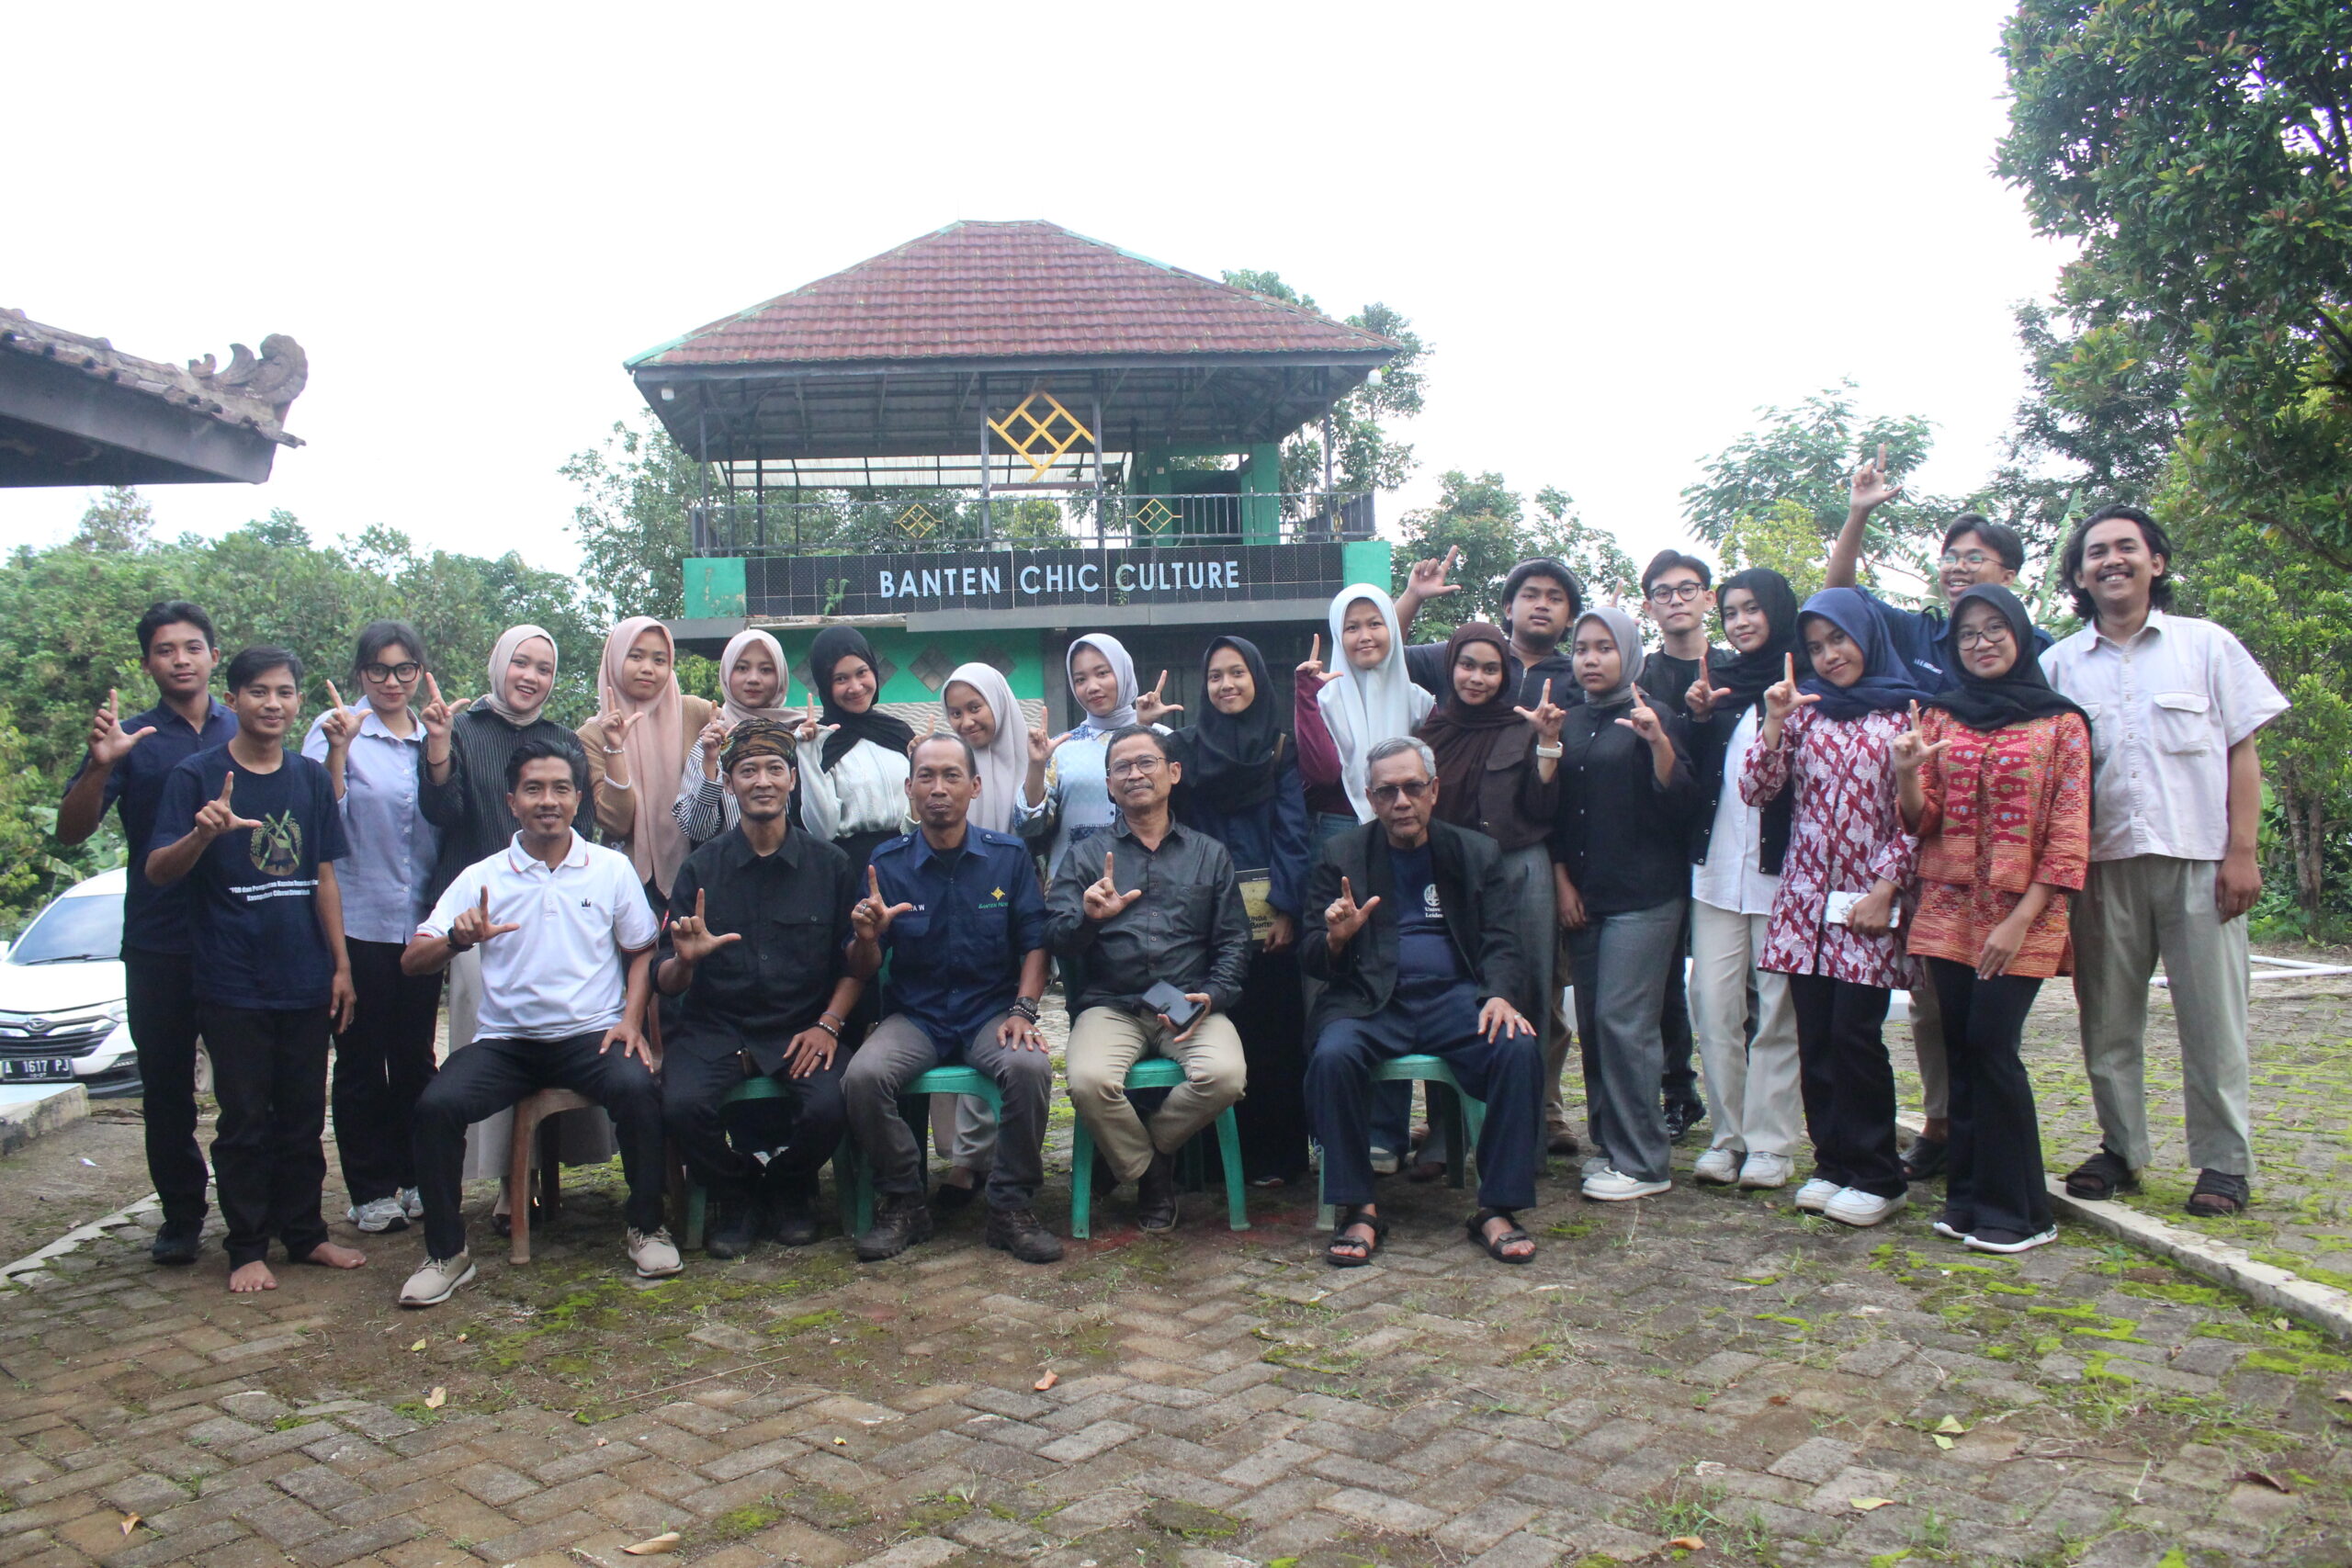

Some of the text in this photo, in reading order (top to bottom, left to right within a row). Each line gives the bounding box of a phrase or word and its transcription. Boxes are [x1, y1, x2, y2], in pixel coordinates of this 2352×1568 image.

[879, 560, 1239, 598] BANTEN CHIC CULTURE
[5, 1059, 70, 1074] A 1617 PJ
